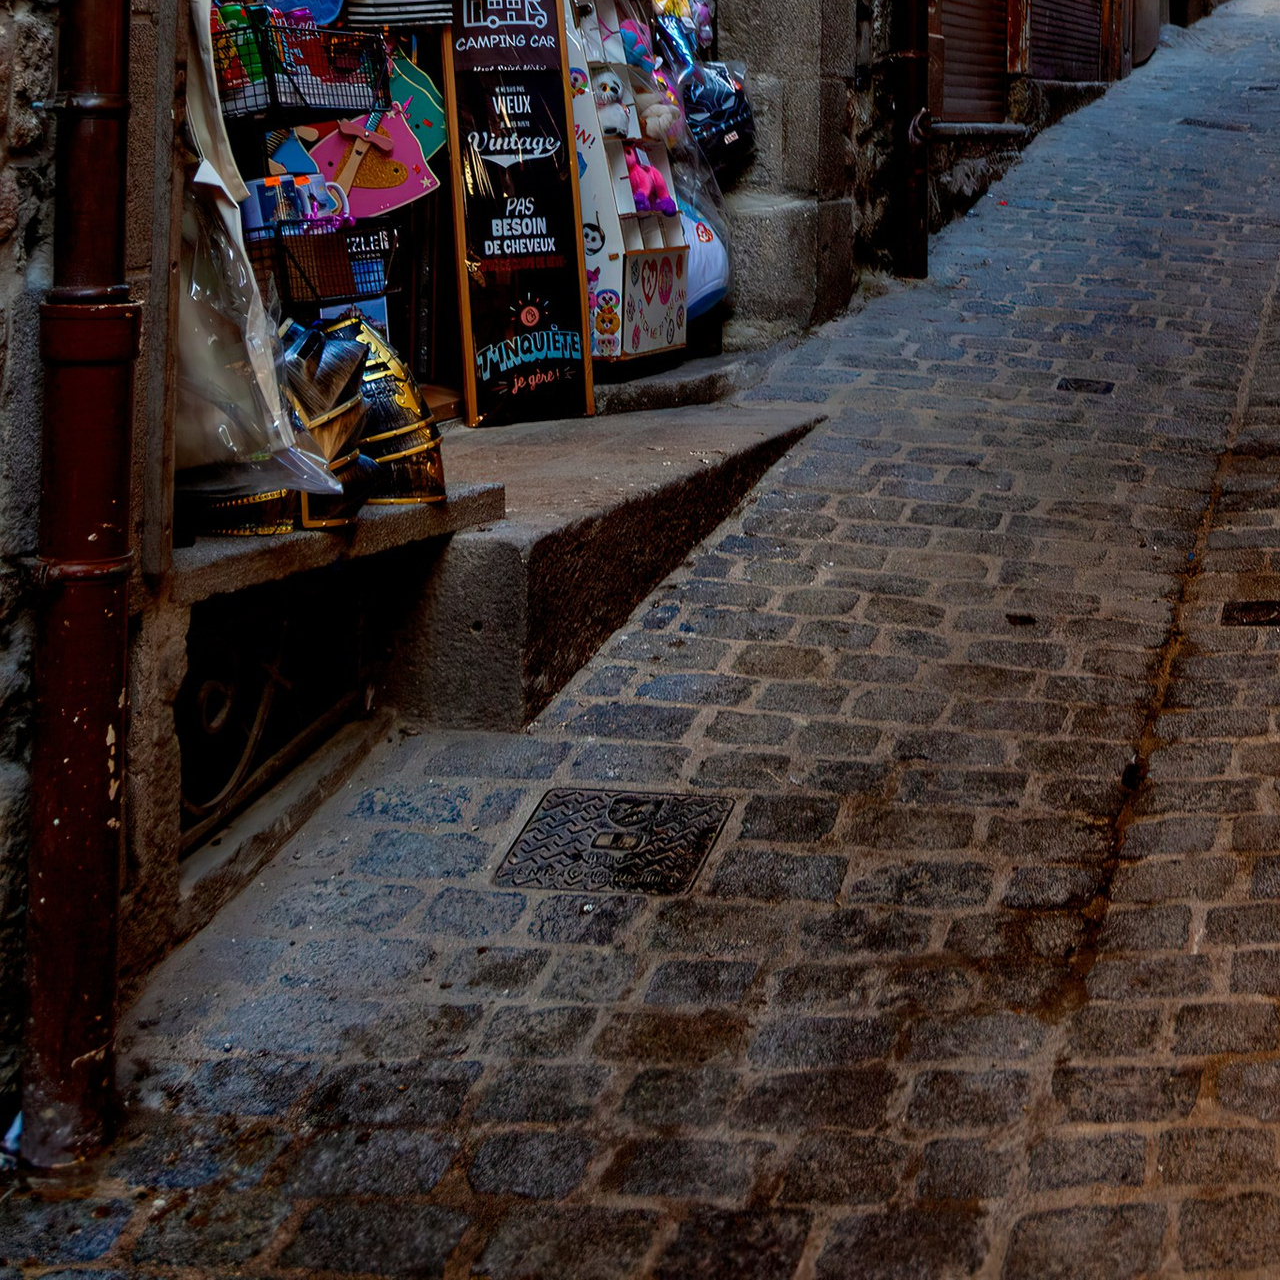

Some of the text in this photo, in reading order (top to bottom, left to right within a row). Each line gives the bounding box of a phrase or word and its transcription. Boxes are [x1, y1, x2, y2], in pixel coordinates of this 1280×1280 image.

[455, 34, 555, 51] CAMPING CAR
[467, 131, 558, 155] Vintage
[506, 196, 534, 215] PAS
[491, 217, 547, 237] BESOIN
[484, 237, 556, 255] DE CHEVEUX
[512, 374, 526, 394] je
